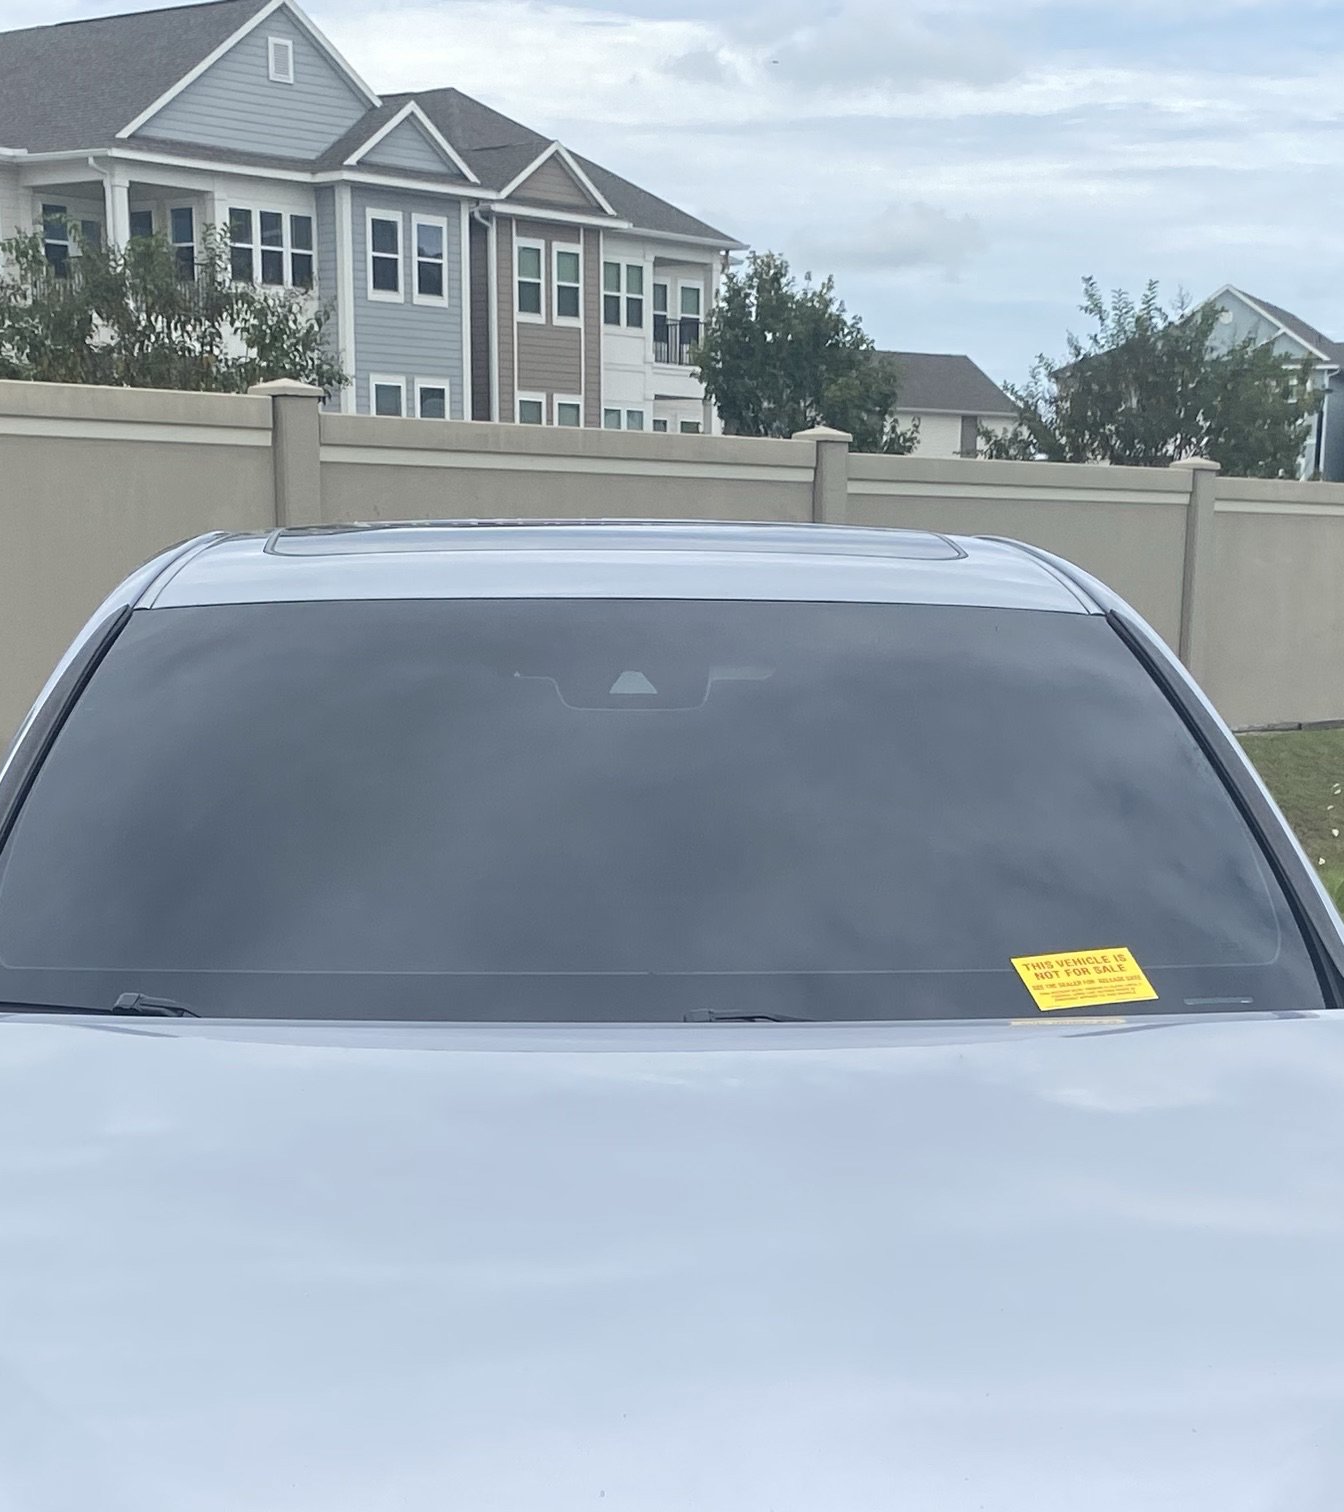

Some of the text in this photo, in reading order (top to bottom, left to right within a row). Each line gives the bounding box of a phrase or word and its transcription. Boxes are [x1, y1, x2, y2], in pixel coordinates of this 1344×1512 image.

[1022, 954, 1127, 971] THIS VEHICLE IS
[1034, 964, 1127, 980] NOT FOR SALE
